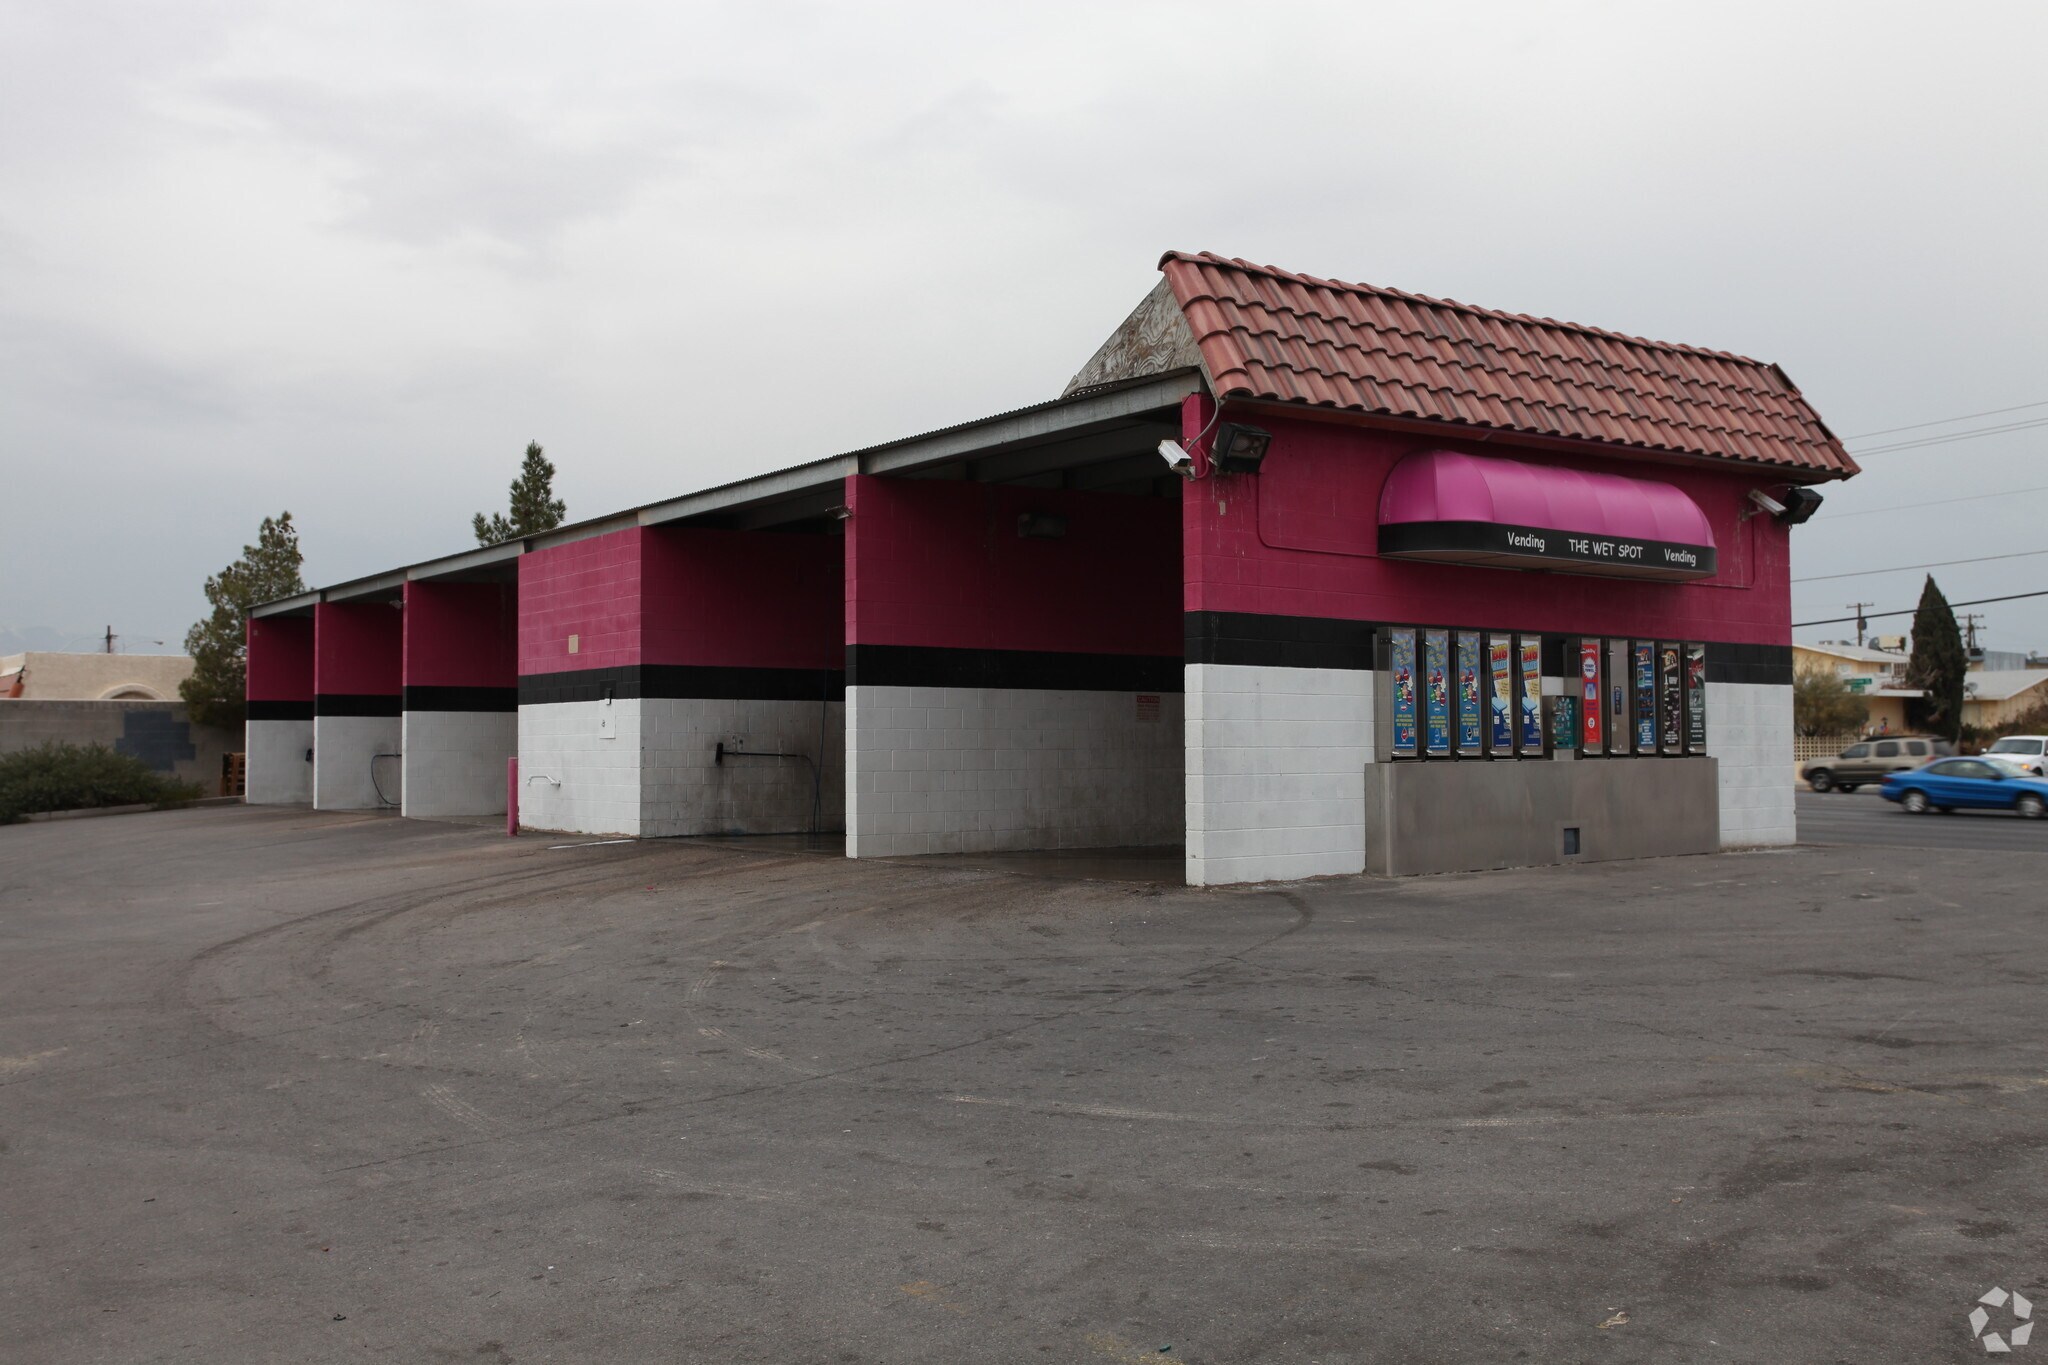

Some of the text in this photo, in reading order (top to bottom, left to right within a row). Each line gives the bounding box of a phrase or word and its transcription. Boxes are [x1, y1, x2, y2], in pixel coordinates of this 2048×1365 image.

[1507, 531, 1545, 552] Vending
[1568, 539, 1643, 559] THE WET SPOT
[1664, 549, 1696, 567] Vending
